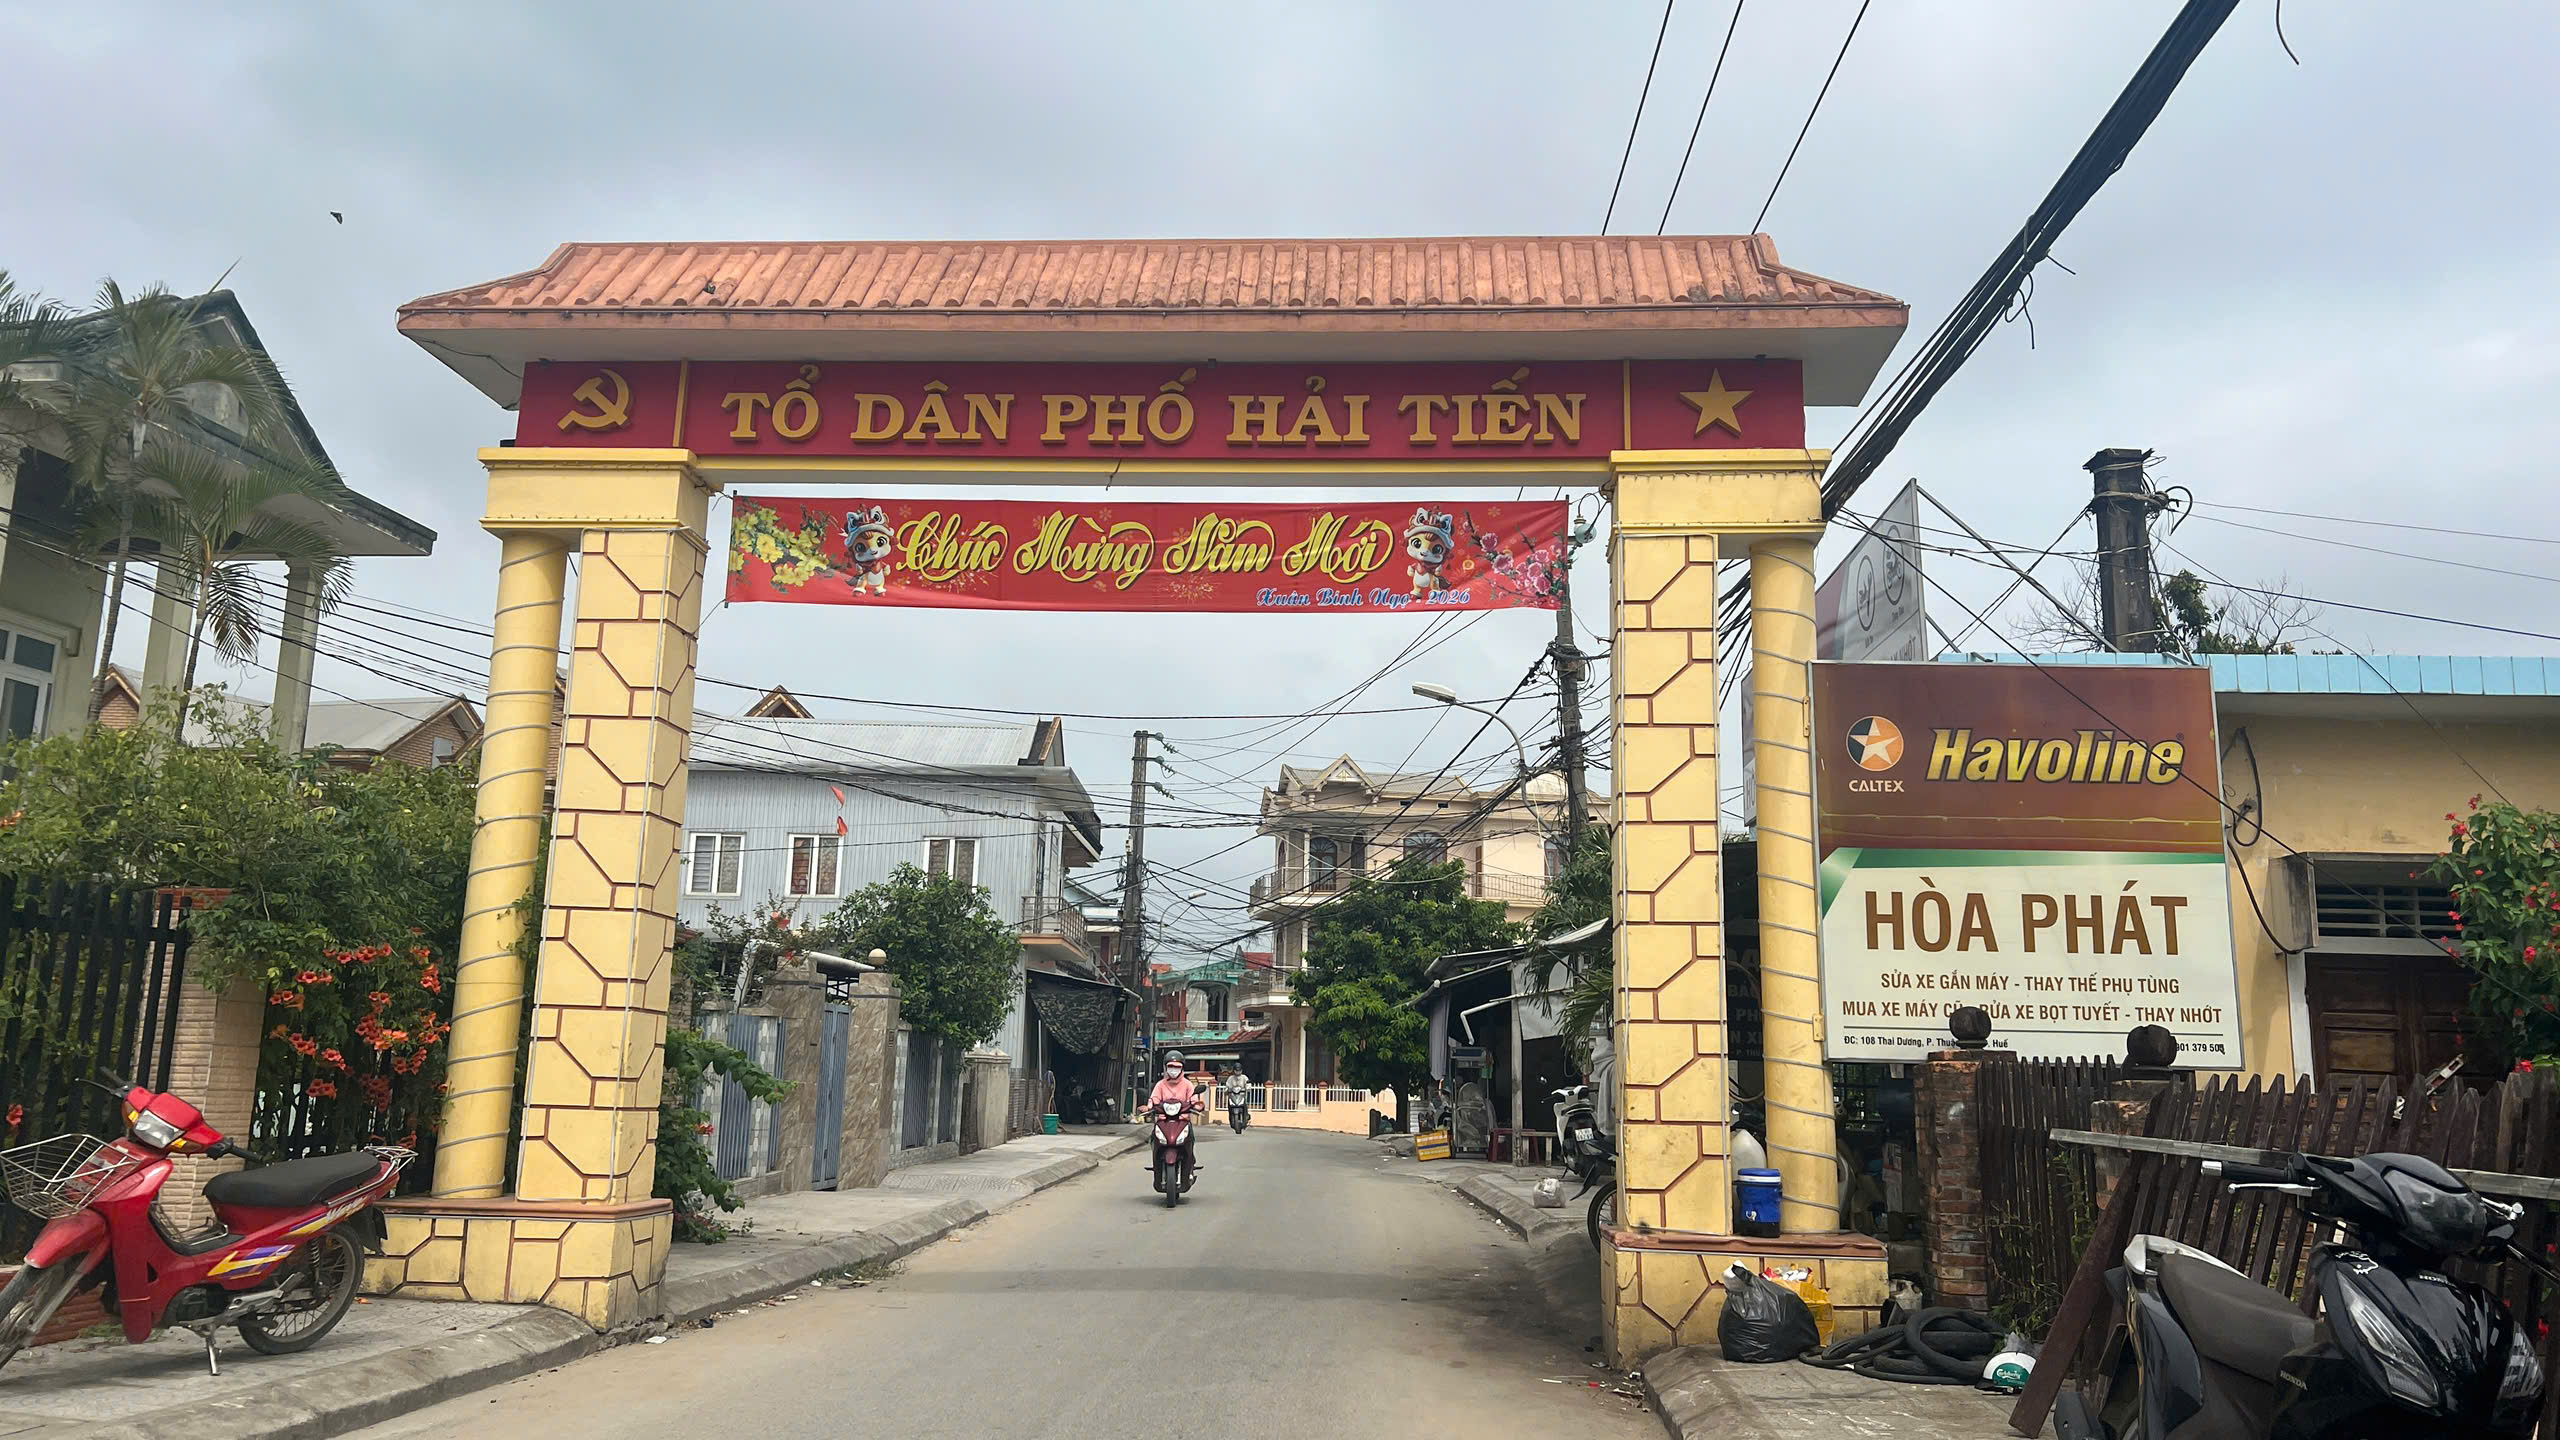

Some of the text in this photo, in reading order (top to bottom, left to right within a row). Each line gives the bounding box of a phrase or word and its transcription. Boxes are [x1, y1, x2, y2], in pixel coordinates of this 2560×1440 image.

[721, 364, 1586, 445] TỔ DÂN PHỐ HẢI TIẾN
[896, 510, 1009, 582] Chúc
[1013, 510, 1154, 590] Mừng
[1281, 512, 1394, 584] Mới
[1256, 587, 1310, 607] Xuân
[1369, 587, 1412, 609] Ngọ
[1425, 588, 1471, 605] 2026
[1925, 727, 2186, 786] Havoline
[1848, 779, 1905, 794] CALTEX
[1864, 876, 2188, 956] HÒA PHÁT
[1881, 968, 1912, 989] SỬA
[1916, 974, 1935, 989] XE
[1939, 969, 1971, 990] GẮN
[1976, 972, 2009, 991] MÁY
[2024, 976, 2063, 992] THAY
[2069, 972, 2098, 992] THẾ
[2102, 977, 2133, 996] PHỤ
[2137, 975, 2180, 994] TÙNG
[1842, 1001, 1877, 1017] MUA
[1881, 1002, 1900, 1017] XE
[1905, 999, 1938, 1018] MÁY
[2015, 1004, 2035, 1020] XE
[2039, 1005, 2068, 1023] BỌT
[2072, 1000, 2120, 1021] TUYẾT
[2135, 1007, 2175, 1022] THAY
[2180, 1004, 2222, 1023] NHỚT
[1844, 1035, 1858, 1045] ĐC:
[1861, 1036, 1876, 1045] 108
[1926, 1038, 1935, 1046] P.
[1992, 1038, 2010, 1048] Huế
[2192, 1043, 2207, 1052] 379
[2280, 1369, 2308, 1391] HONDA
